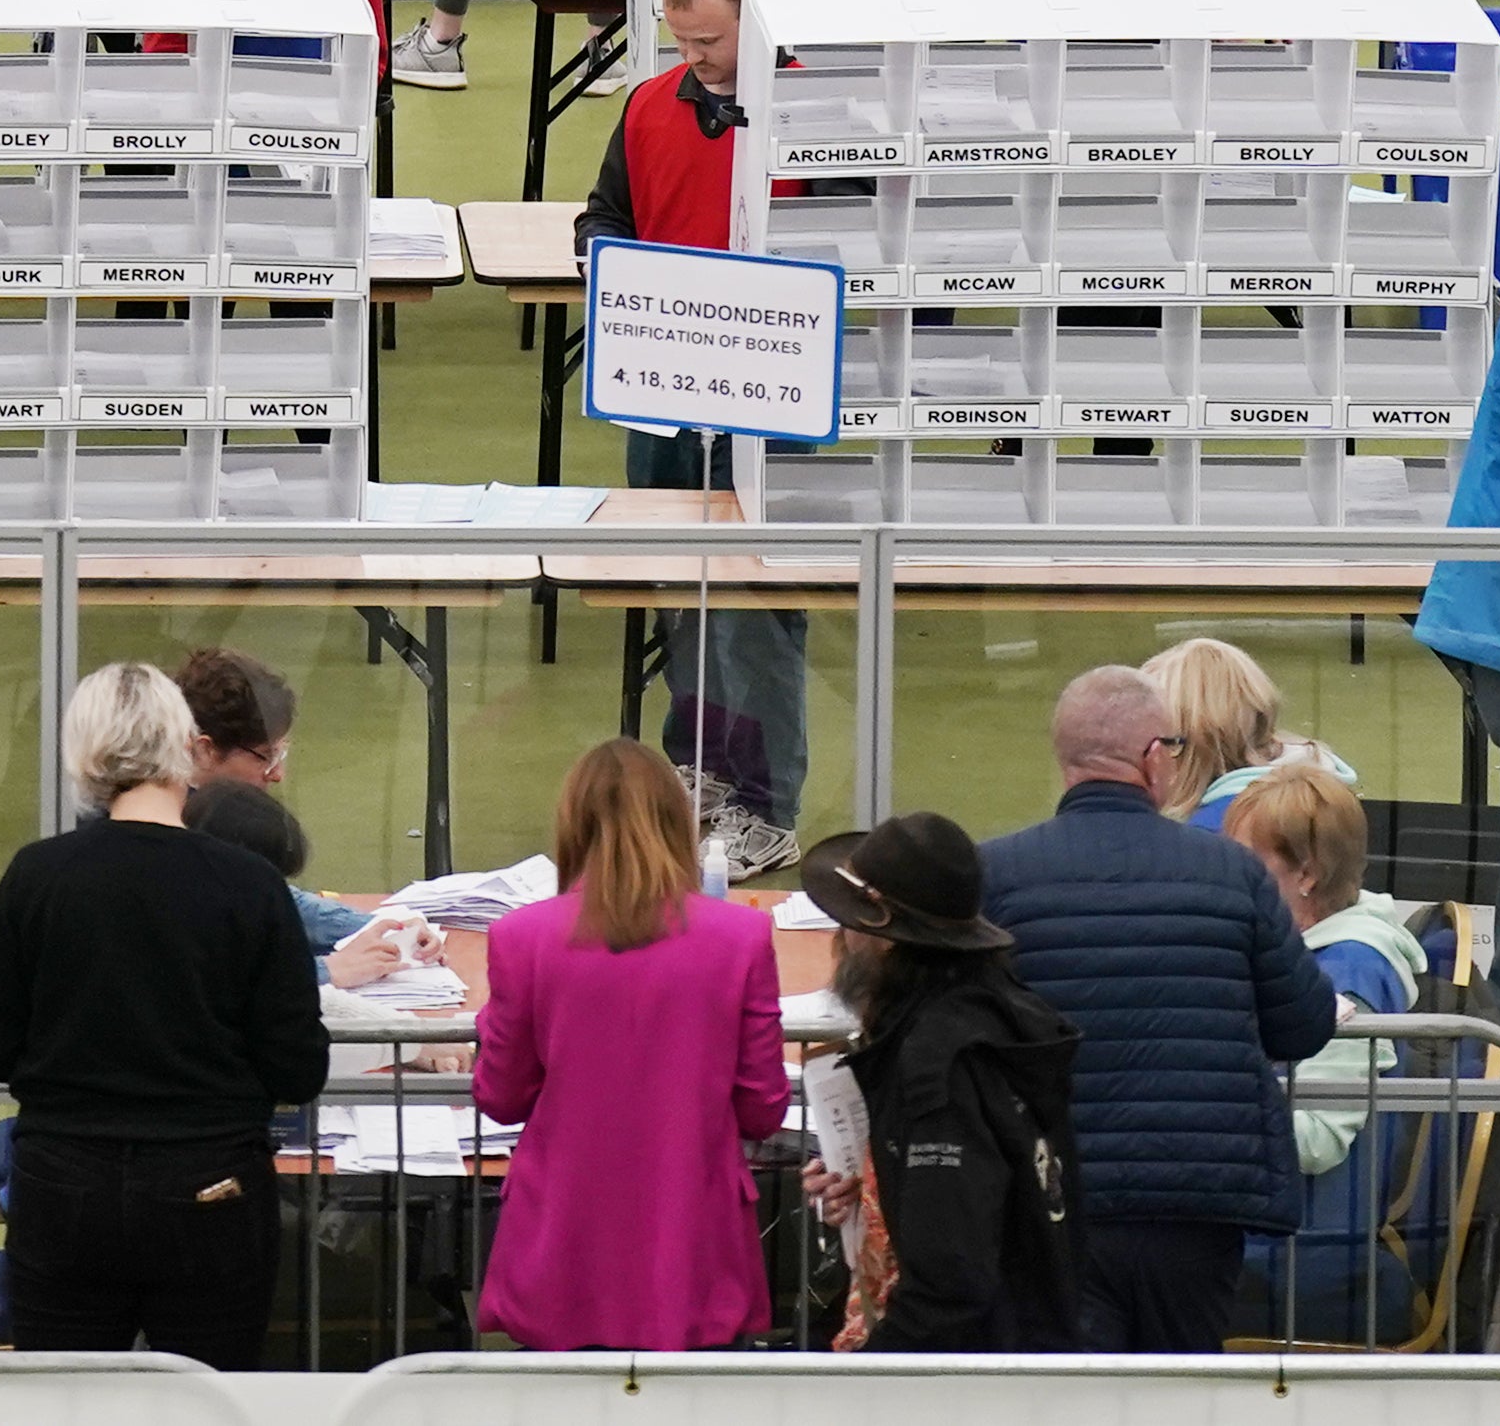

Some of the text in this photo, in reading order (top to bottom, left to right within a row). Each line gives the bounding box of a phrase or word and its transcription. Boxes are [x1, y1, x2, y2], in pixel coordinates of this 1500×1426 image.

[114, 136, 186, 148] BROLLY
[249, 134, 340, 149] COULSON
[788, 147, 1467, 166] ARCHIBALD ARMSTRONG BRADLEY BROLLY COULSON
[104, 269, 184, 281] MERRON
[255, 272, 333, 290] MURPHY
[944, 275, 1455, 295] MCCAW MCGURK MERRON MURPHY
[601, 292, 819, 335] EAST LONDONDERRY
[603, 322, 801, 355] VERIFICATION OF BOXES
[638, 369, 802, 404] 18, 32, 46, 60, 70
[105, 404, 182, 415] SUGDEN
[250, 404, 327, 415] WATTON
[929, 409, 1450, 428] ROBINSON STEWART SUGDEN WATTON
